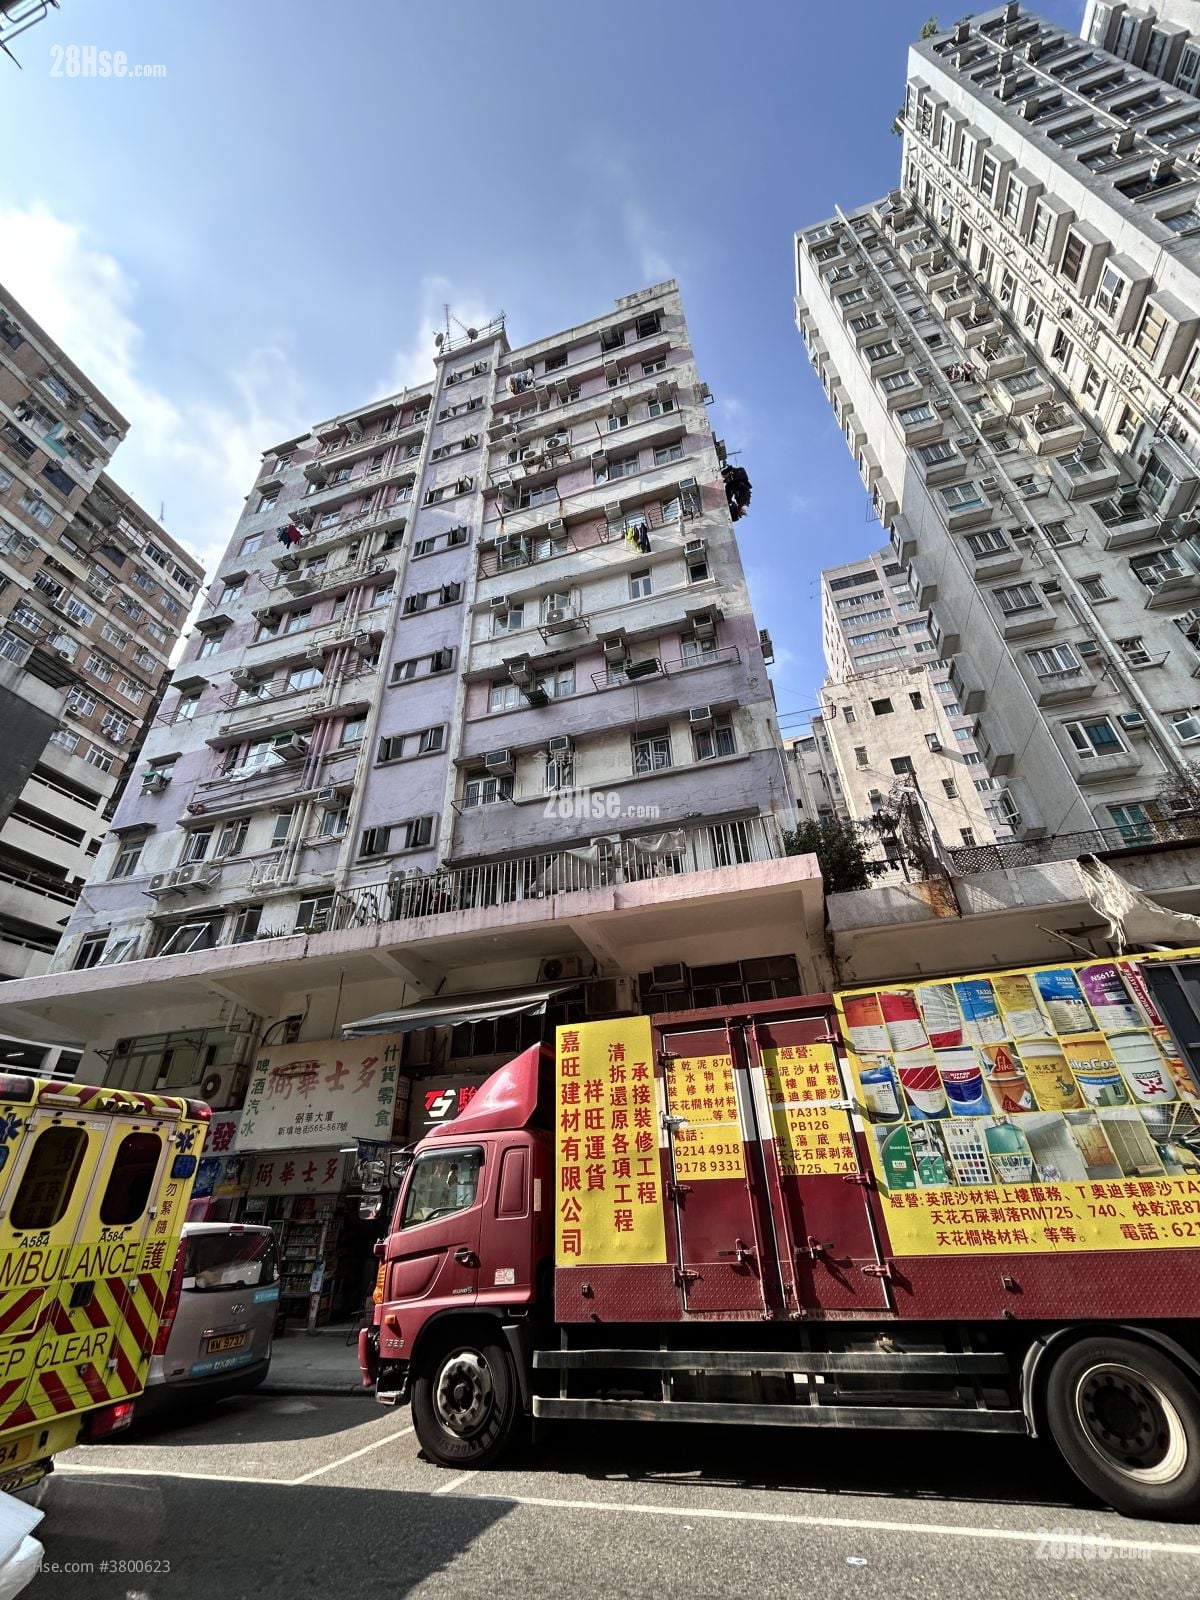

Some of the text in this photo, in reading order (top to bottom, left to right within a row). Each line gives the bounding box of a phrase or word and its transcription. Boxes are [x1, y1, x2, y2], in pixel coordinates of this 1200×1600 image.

[240, 1058, 271, 1138] 啤酒汽水
[788, 1106, 827, 1118] TA313
[584, 1079, 606, 1191] 祥旺運貨
[608, 1043, 634, 1232] 清拆還原各項工程
[632, 1062, 658, 1204] 承接裝修工程
[790, 1120, 829, 1132] PB126
[561, 1030, 582, 1257] 嘉旺建材有限公司
[675, 1143, 740, 1157] 6214 4918
[676, 1160, 742, 1174] 9178 9331
[19, 1233, 51, 1248] A584
[98, 1230, 124, 1243] A584
[140, 1240, 167, 1272] 護
[34, 1332, 108, 1369] CLEAR
